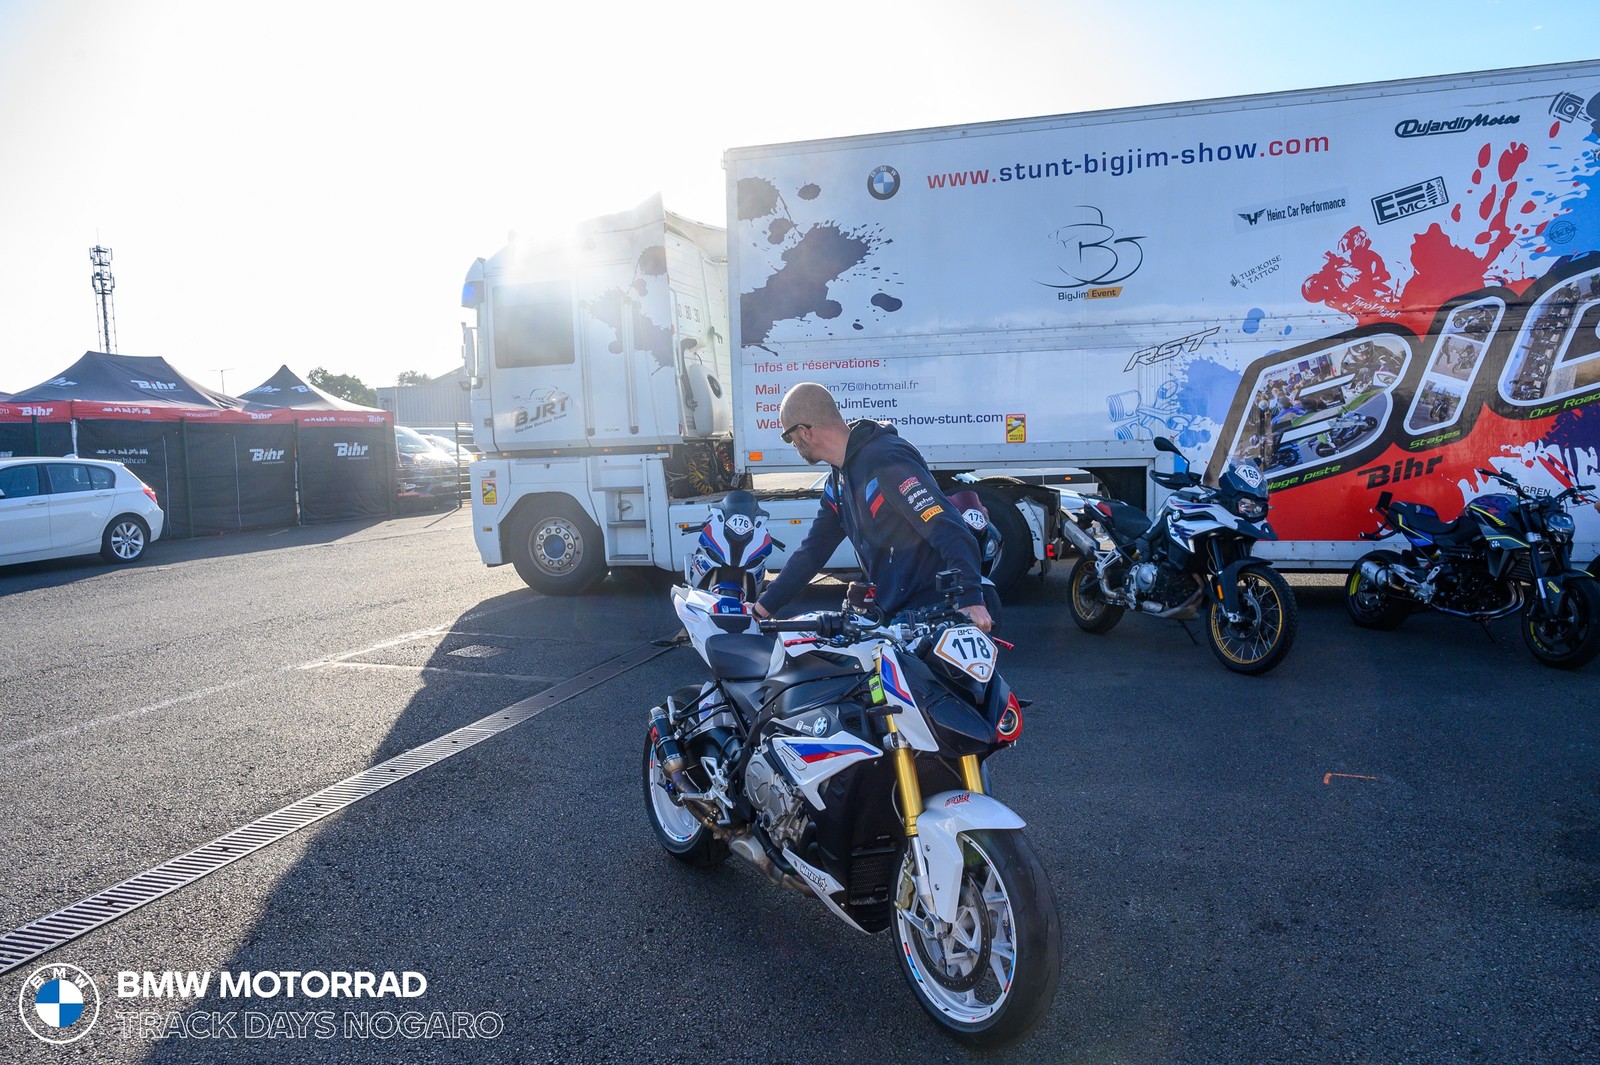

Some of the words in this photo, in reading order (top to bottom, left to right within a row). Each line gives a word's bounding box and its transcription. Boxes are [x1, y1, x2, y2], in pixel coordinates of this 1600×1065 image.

[926, 136, 1330, 190] www.stunt-bigjim-show.com
[1266, 208, 1287, 222] Heinz
[1287, 205, 1300, 217] Car
[1300, 198, 1346, 215] Performance
[1248, 264, 1280, 285] TATTOO
[1057, 291, 1089, 301] BigJim
[1091, 289, 1117, 298] Event
[754, 362, 783, 373] Infos
[786, 362, 799, 372] et
[802, 358, 880, 371] réservations
[130, 379, 177, 390] Bihr
[755, 384, 780, 395] Mail
[824, 380, 919, 392] im76@hotmail.fr
[17, 406, 54, 416] Bihr
[515, 396, 569, 427] BJRT
[755, 401, 782, 412] Face
[367, 414, 385, 423] Bihr
[1409, 429, 1462, 449] Stages
[250, 448, 285, 462] Bihr
[333, 442, 368, 457] Bihr
[1242, 468, 1259, 480] 169
[1267, 476, 1299, 490] lage
[1302, 465, 1341, 482] piste
[1357, 455, 1444, 490] Bihr
[732, 518, 749, 529] 176
[968, 512, 984, 524] 175
[951, 637, 991, 660] 178
[978, 665, 985, 675] 7
